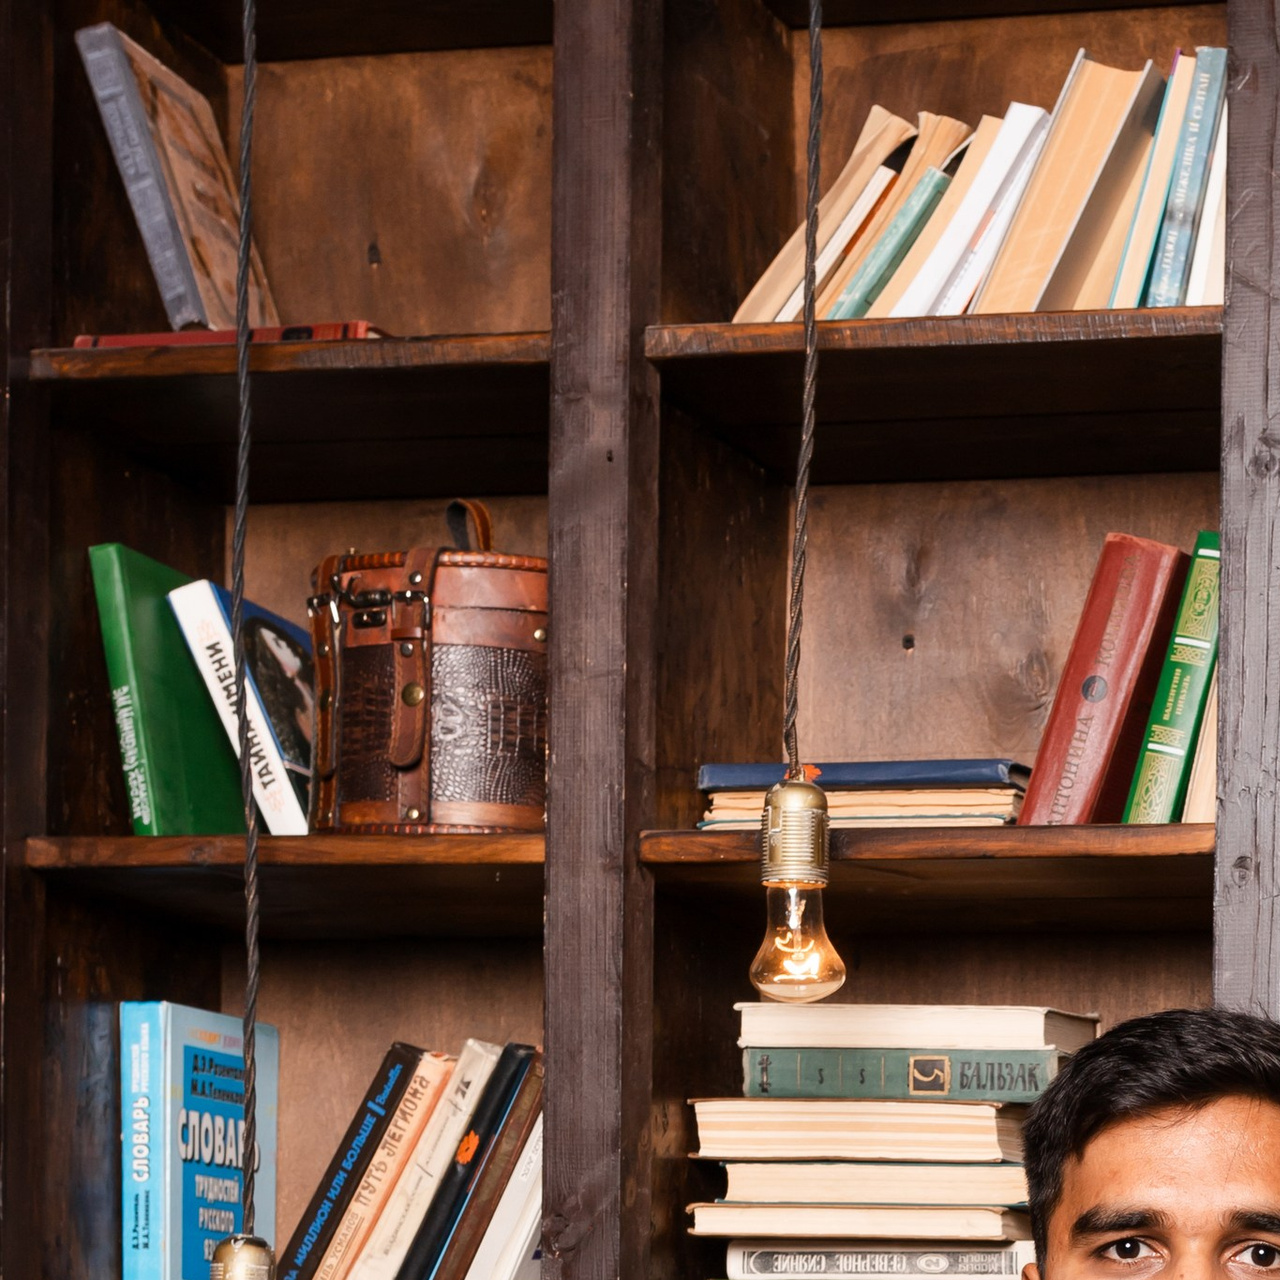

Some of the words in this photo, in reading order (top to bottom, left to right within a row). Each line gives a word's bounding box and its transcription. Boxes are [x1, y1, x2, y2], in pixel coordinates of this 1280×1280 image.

[1173, 135, 1197, 205] АНЖЕЛИКА
[1190, 72, 1211, 120] СУЛТАН
[203, 640, 247, 715] ИМЕНИ
[1160, 667, 1183, 723] ВАЛЕНТИН
[1172, 673, 1191, 716] ПИКУЛЬ
[1044, 710, 1095, 829] АНТОНИНА
[959, 1061, 1040, 1092] БАЛЬЗАК
[125, 1096, 157, 1183] СЛОВАРЬ
[195, 1174, 239, 1204] ТРУДНОСТЕЙ
[292, 1199, 335, 1268] МИЛЛИОН
[325, 1170, 349, 1201] ИЛИ
[339, 1112, 377, 1171] БОЛЬШЕ
[328, 1210, 361, 1261] УСМАНОВ
[353, 1157, 390, 1209] ПУТЬ
[198, 1207, 235, 1233] РУССКОГО
[773, 1253, 826, 1272] СИЯНИЕ
[835, 1253, 906, 1272] СЕВЕРНОЕ
